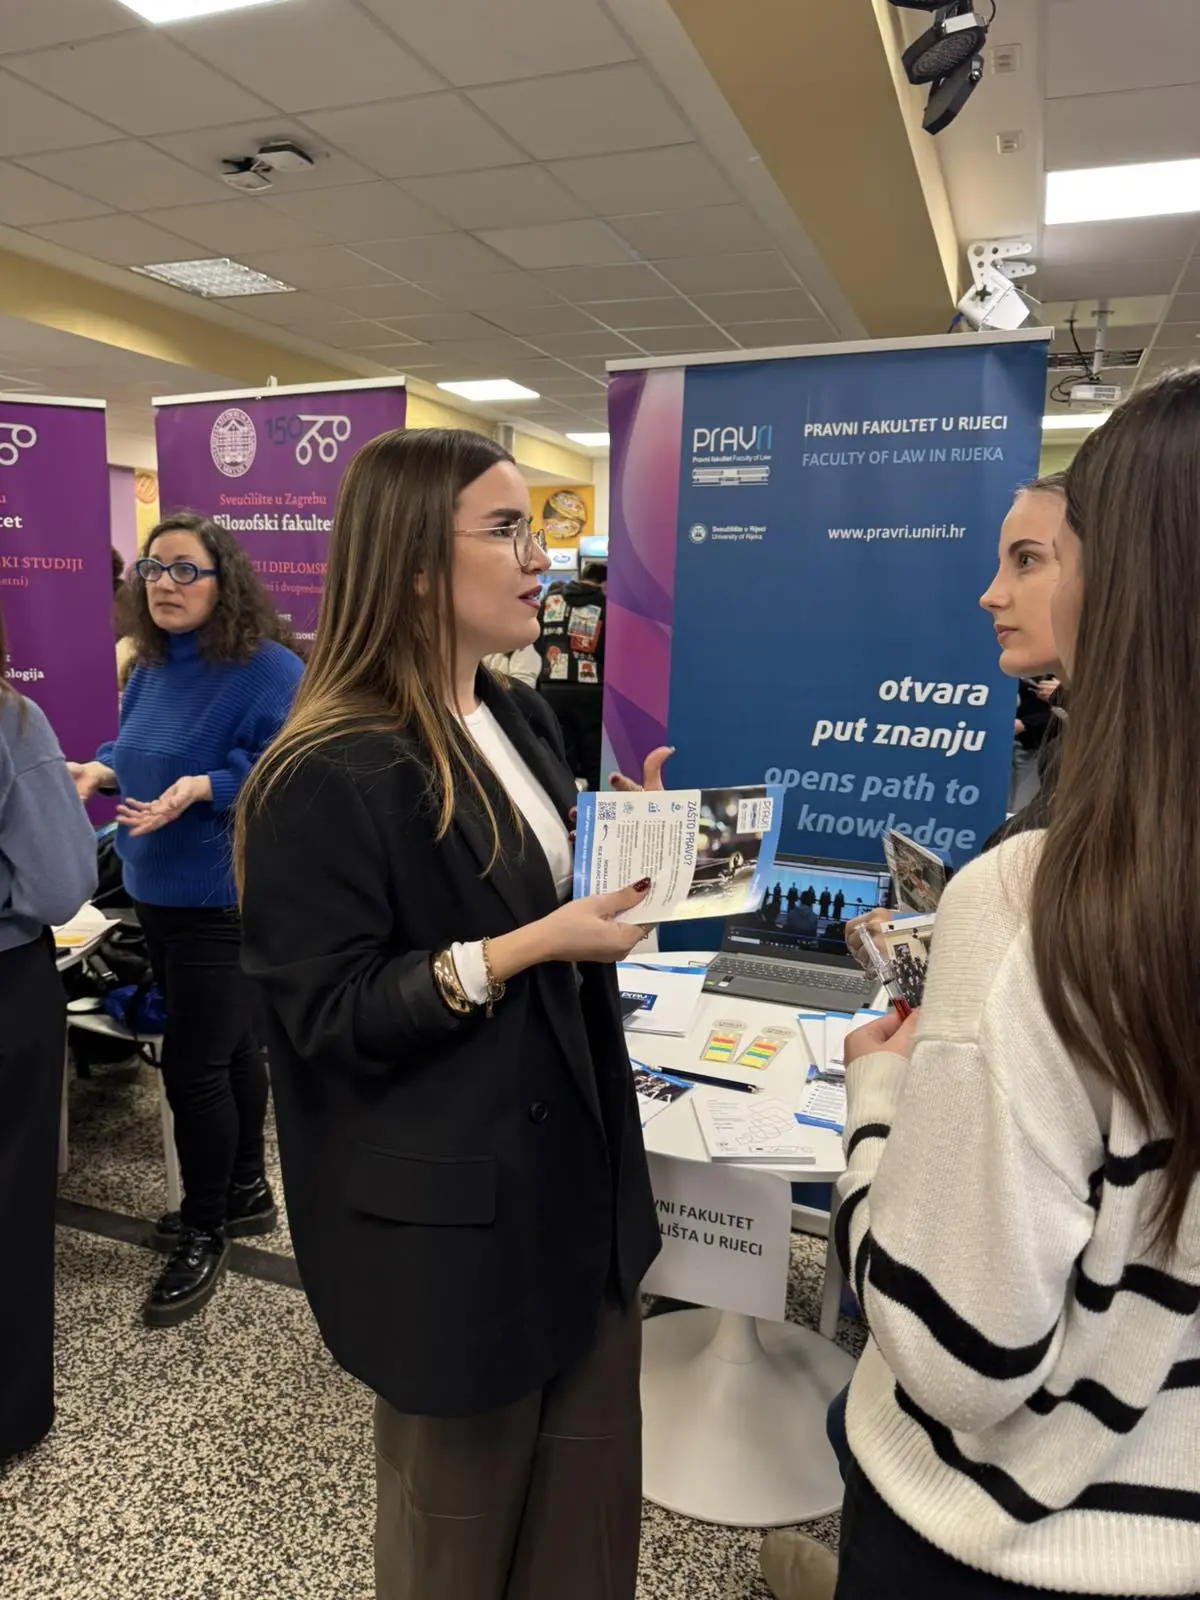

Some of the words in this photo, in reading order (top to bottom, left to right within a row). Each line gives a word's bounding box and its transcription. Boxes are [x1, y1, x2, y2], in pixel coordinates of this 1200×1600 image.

[804, 421, 858, 437] PRAVNI
[862, 417, 938, 434] FAKULTET
[942, 417, 954, 431] U
[958, 415, 1008, 430] RIJECI
[802, 451, 865, 467] FACULTY
[869, 450, 889, 464] OF
[893, 449, 925, 463] LAW
[929, 449, 946, 462] IN
[951, 447, 1004, 462] RIJEKA
[275, 496, 283, 505] u
[285, 490, 327, 508] Zagrebu
[282, 513, 334, 531] fakulte
[828, 524, 967, 542] www.pravri.uniri.hr
[22, 556, 84, 572] STUDIJI
[879, 676, 990, 706] otvara
[811, 717, 868, 747] put
[872, 721, 987, 757] znanju
[764, 767, 856, 794] opens
[861, 772, 936, 802] path
[945, 778, 980, 805] to
[686, 801, 698, 830] ZAŠTO
[797, 804, 977, 850] knowledge
[683, 832, 696, 866] PRAVO?
[680, 1204, 754, 1230] FAKULTET
[703, 1232, 714, 1245] U
[719, 1236, 763, 1256] RIJECI
